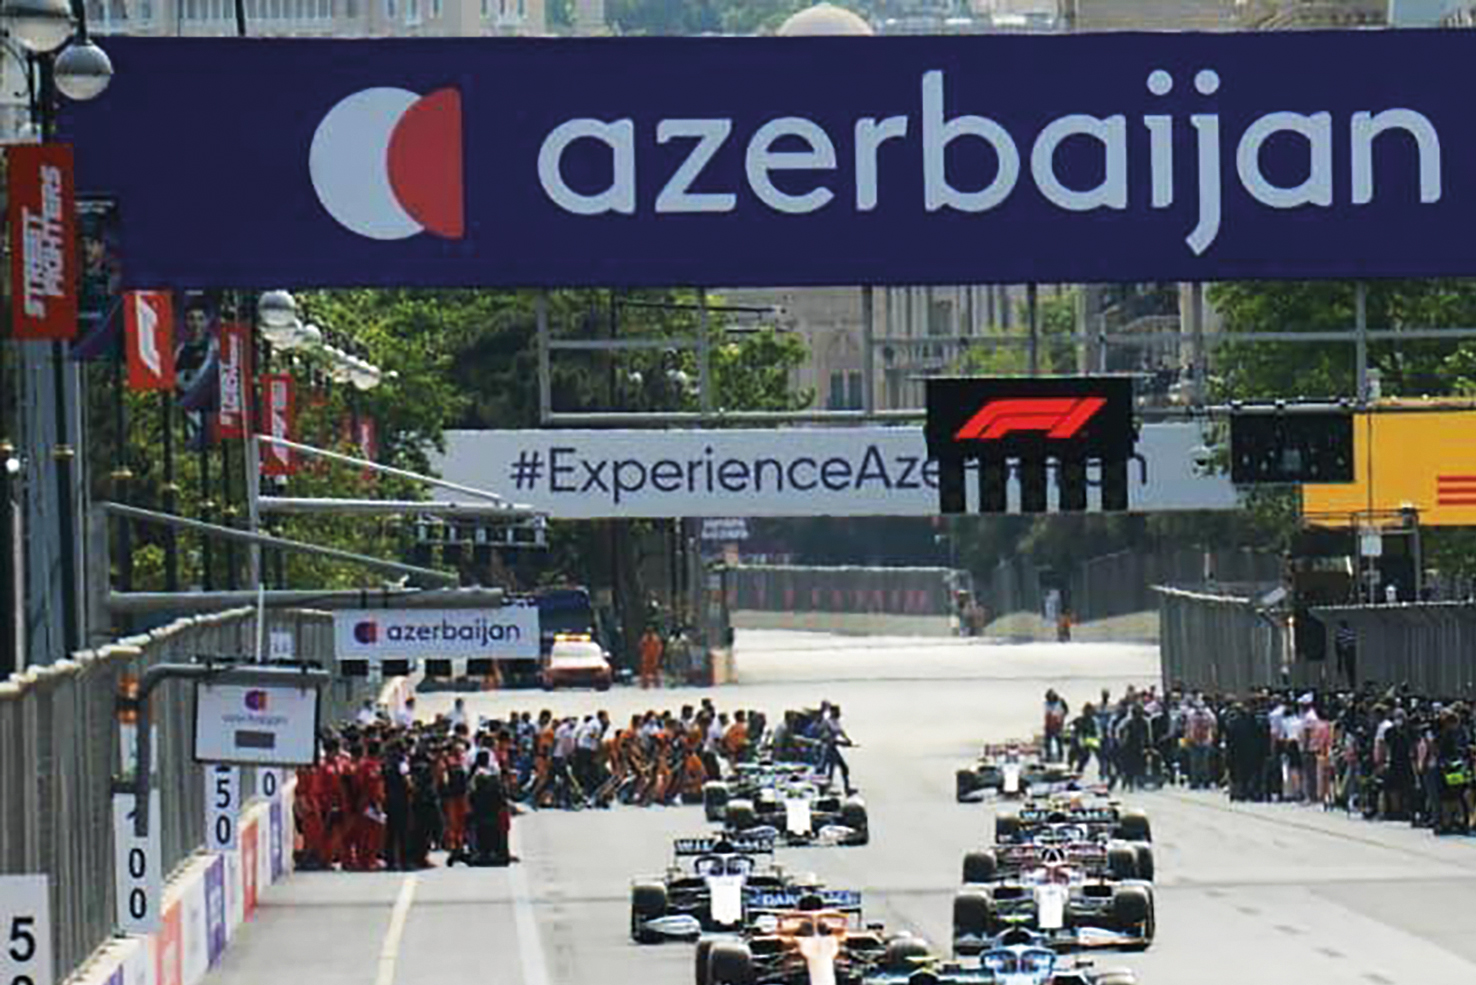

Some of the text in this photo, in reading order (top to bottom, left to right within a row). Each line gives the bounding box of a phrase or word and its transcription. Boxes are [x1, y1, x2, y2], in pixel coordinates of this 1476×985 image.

[538, 69, 1442, 256] azerbaijan
[953, 397, 1107, 441] F1
[387, 617, 521, 647] azerbaijan
